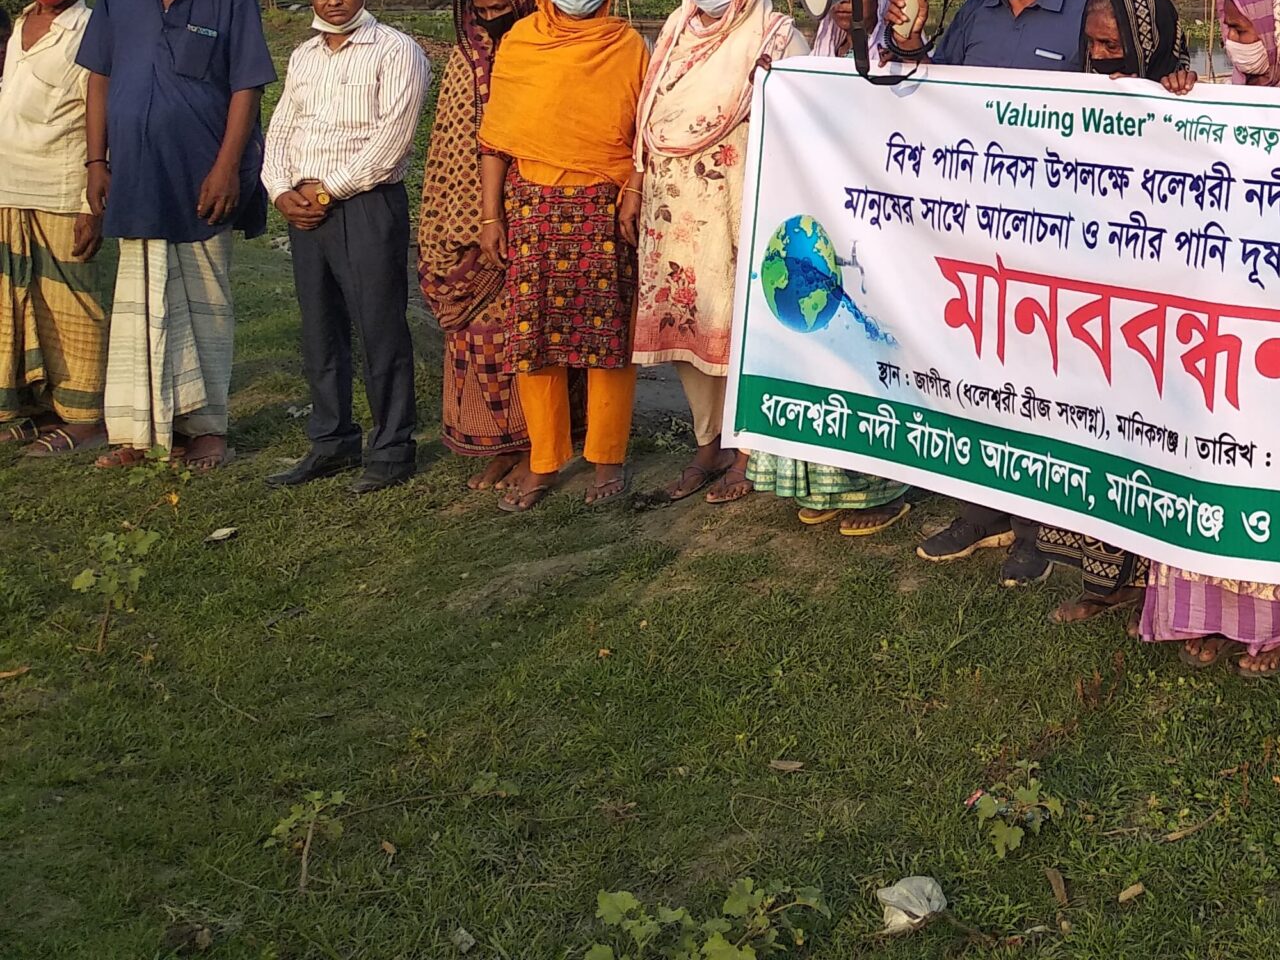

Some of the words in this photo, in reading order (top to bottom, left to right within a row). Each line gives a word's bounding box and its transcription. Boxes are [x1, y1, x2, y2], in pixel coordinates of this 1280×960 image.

[986, 100, 1073, 137] “Valuing
[1081, 108, 1156, 138] Water”
[886, 132, 925, 178] বিশ্ব
[932, 139, 978, 183] পানি
[983, 141, 1038, 190] দিবস
[1044, 147, 1134, 199] উপলক্ষে
[1141, 161, 1236, 212] ধলেশ্বরী
[844, 185, 914, 229] মানুষের
[920, 196, 970, 234] সাথে
[976, 203, 1075, 250] আলোচনা
[1082, 220, 1099, 250] ও
[1108, 211, 1167, 262] নদীর
[1175, 221, 1232, 272] পানি
[914, 368, 951, 400] জাগীর
[1194, 432, 1257, 468] তারিখ
[761, 393, 852, 440] ধলেশ্বরী
[858, 404, 901, 450] নদী
[905, 411, 972, 465] বাঁচাও
[979, 437, 1096, 510] আন্দোলন,
[1105, 469, 1225, 542] মানিকগঞ্জ
[1242, 510, 1271, 542] ও
